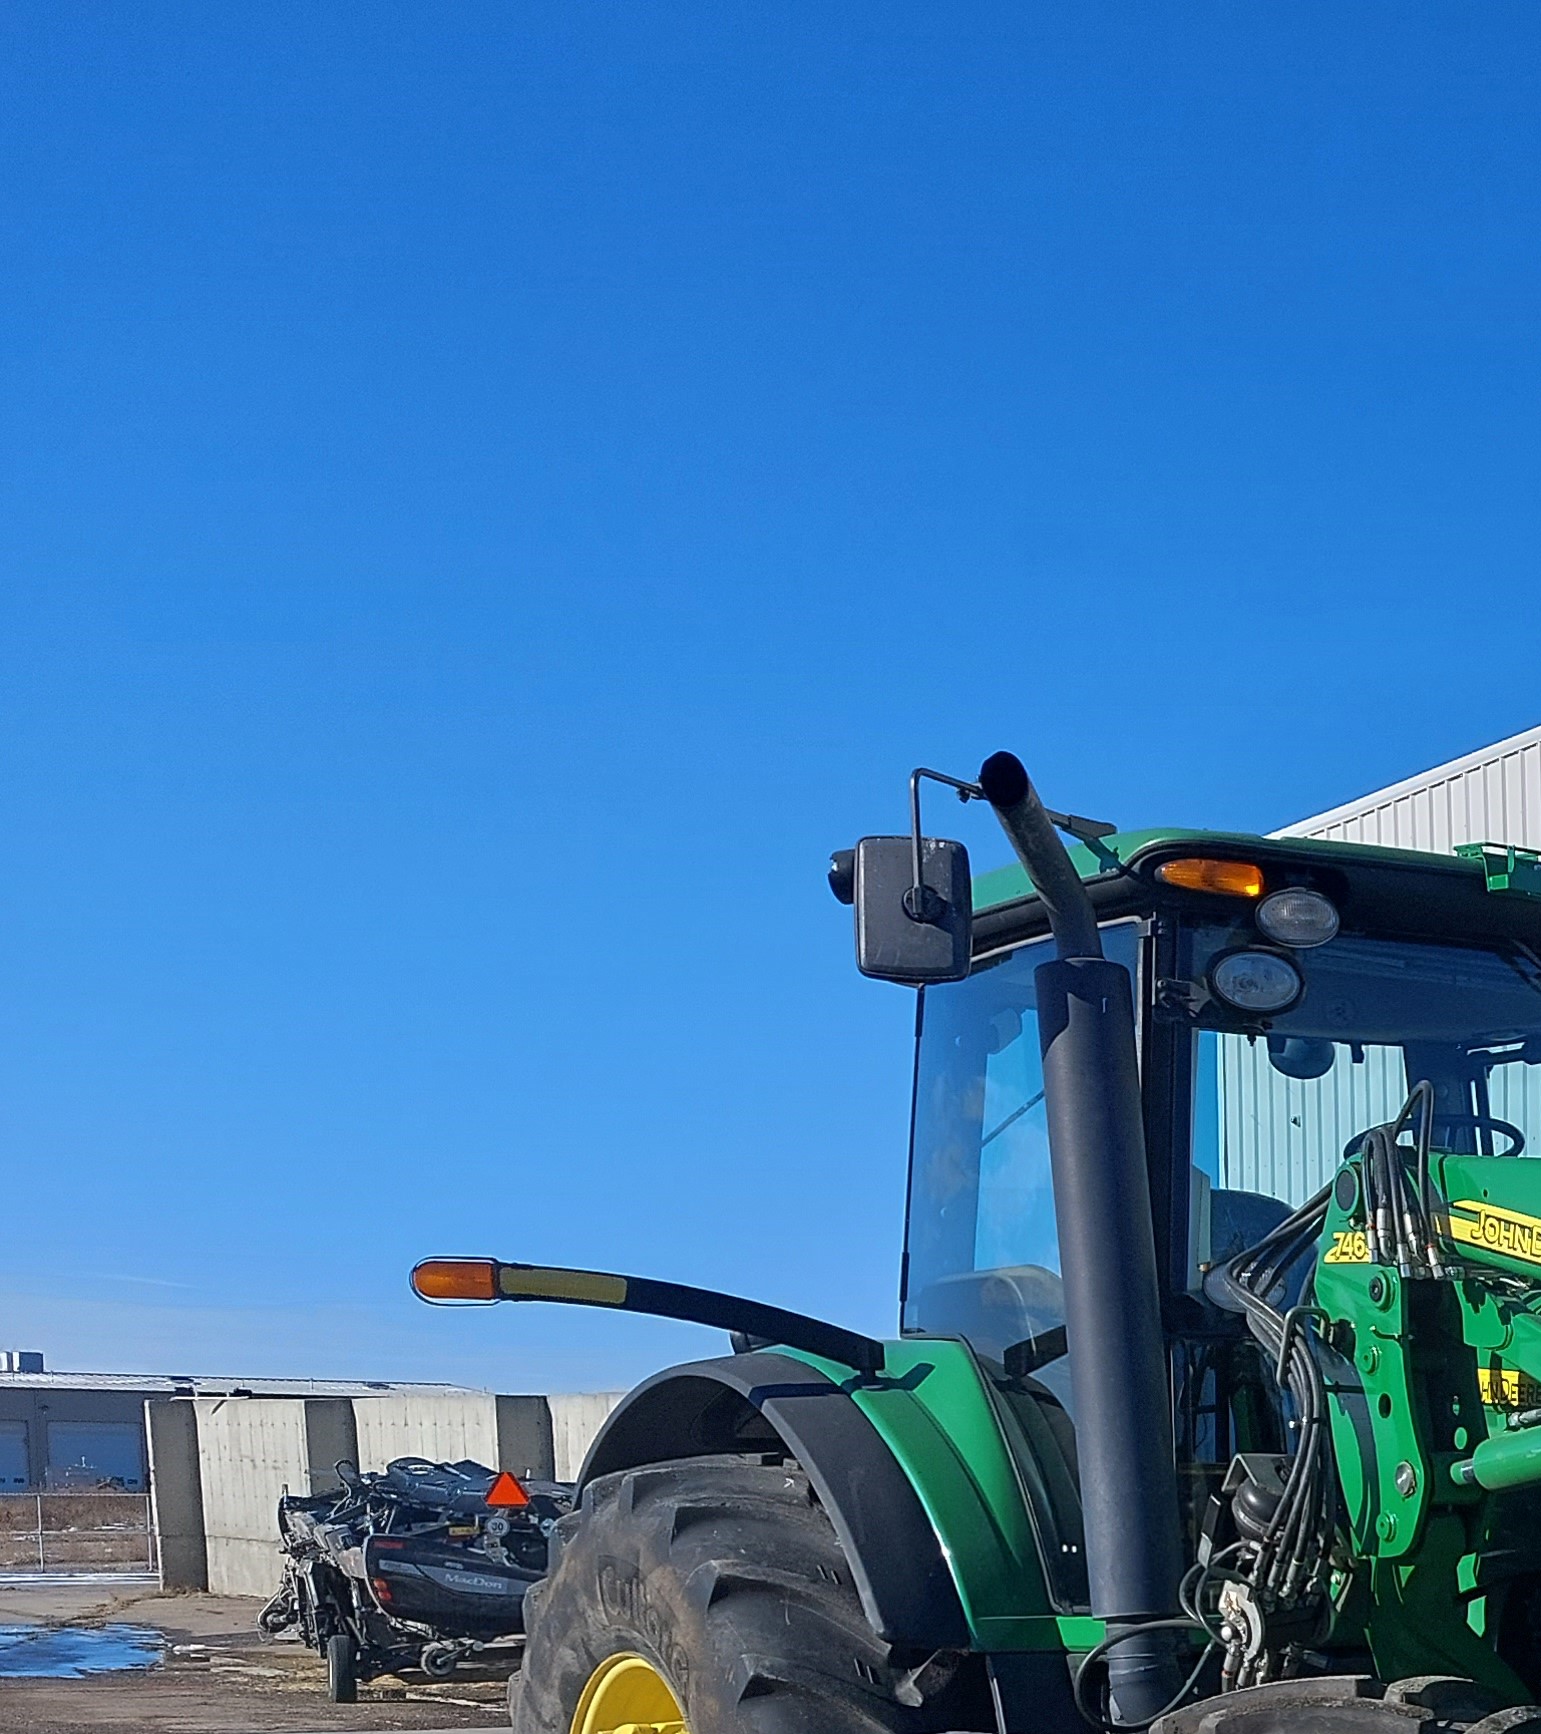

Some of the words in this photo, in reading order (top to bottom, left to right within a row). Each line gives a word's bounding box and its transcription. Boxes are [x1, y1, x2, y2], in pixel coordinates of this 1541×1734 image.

[1471, 1209, 1531, 1253] JOHN
[1333, 1232, 1369, 1260] 746
[445, 1573, 502, 1589] MacDon
